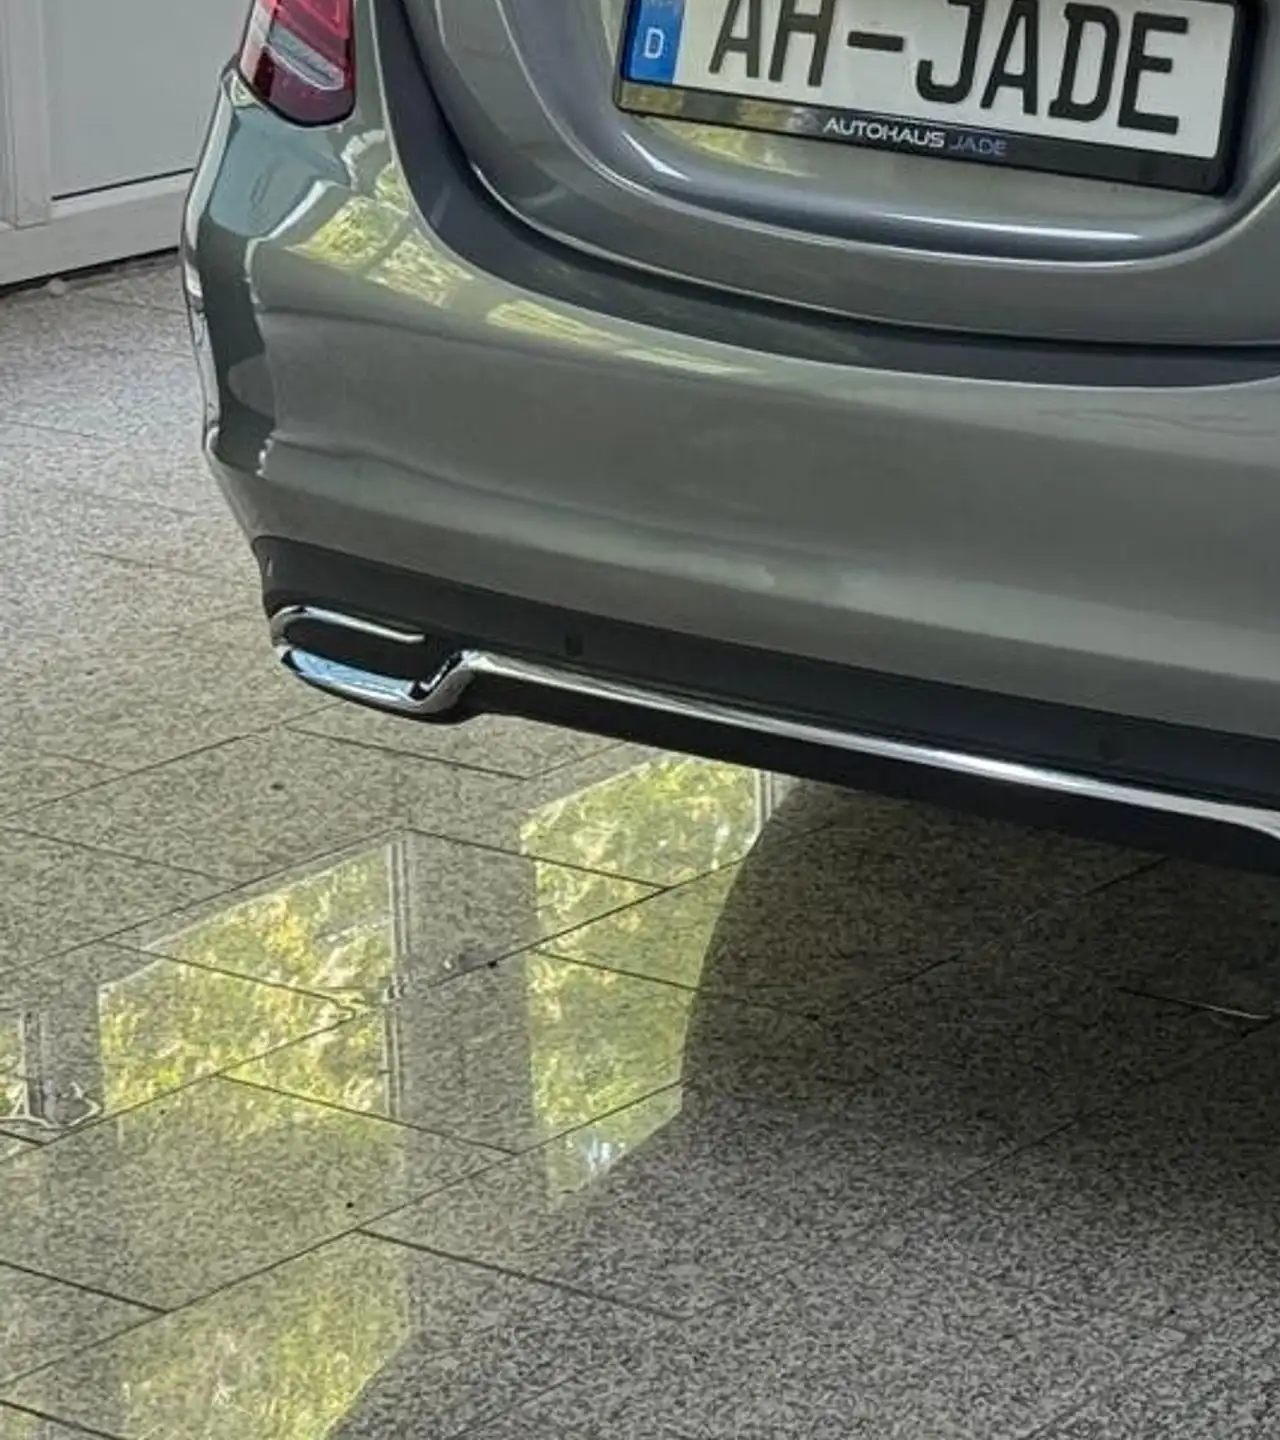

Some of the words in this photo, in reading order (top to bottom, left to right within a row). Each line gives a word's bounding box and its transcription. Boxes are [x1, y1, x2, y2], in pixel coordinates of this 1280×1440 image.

[643, 26, 665, 60] D
[822, 116, 946, 149] AUTOHAUS
[949, 134, 1008, 157] JADE
